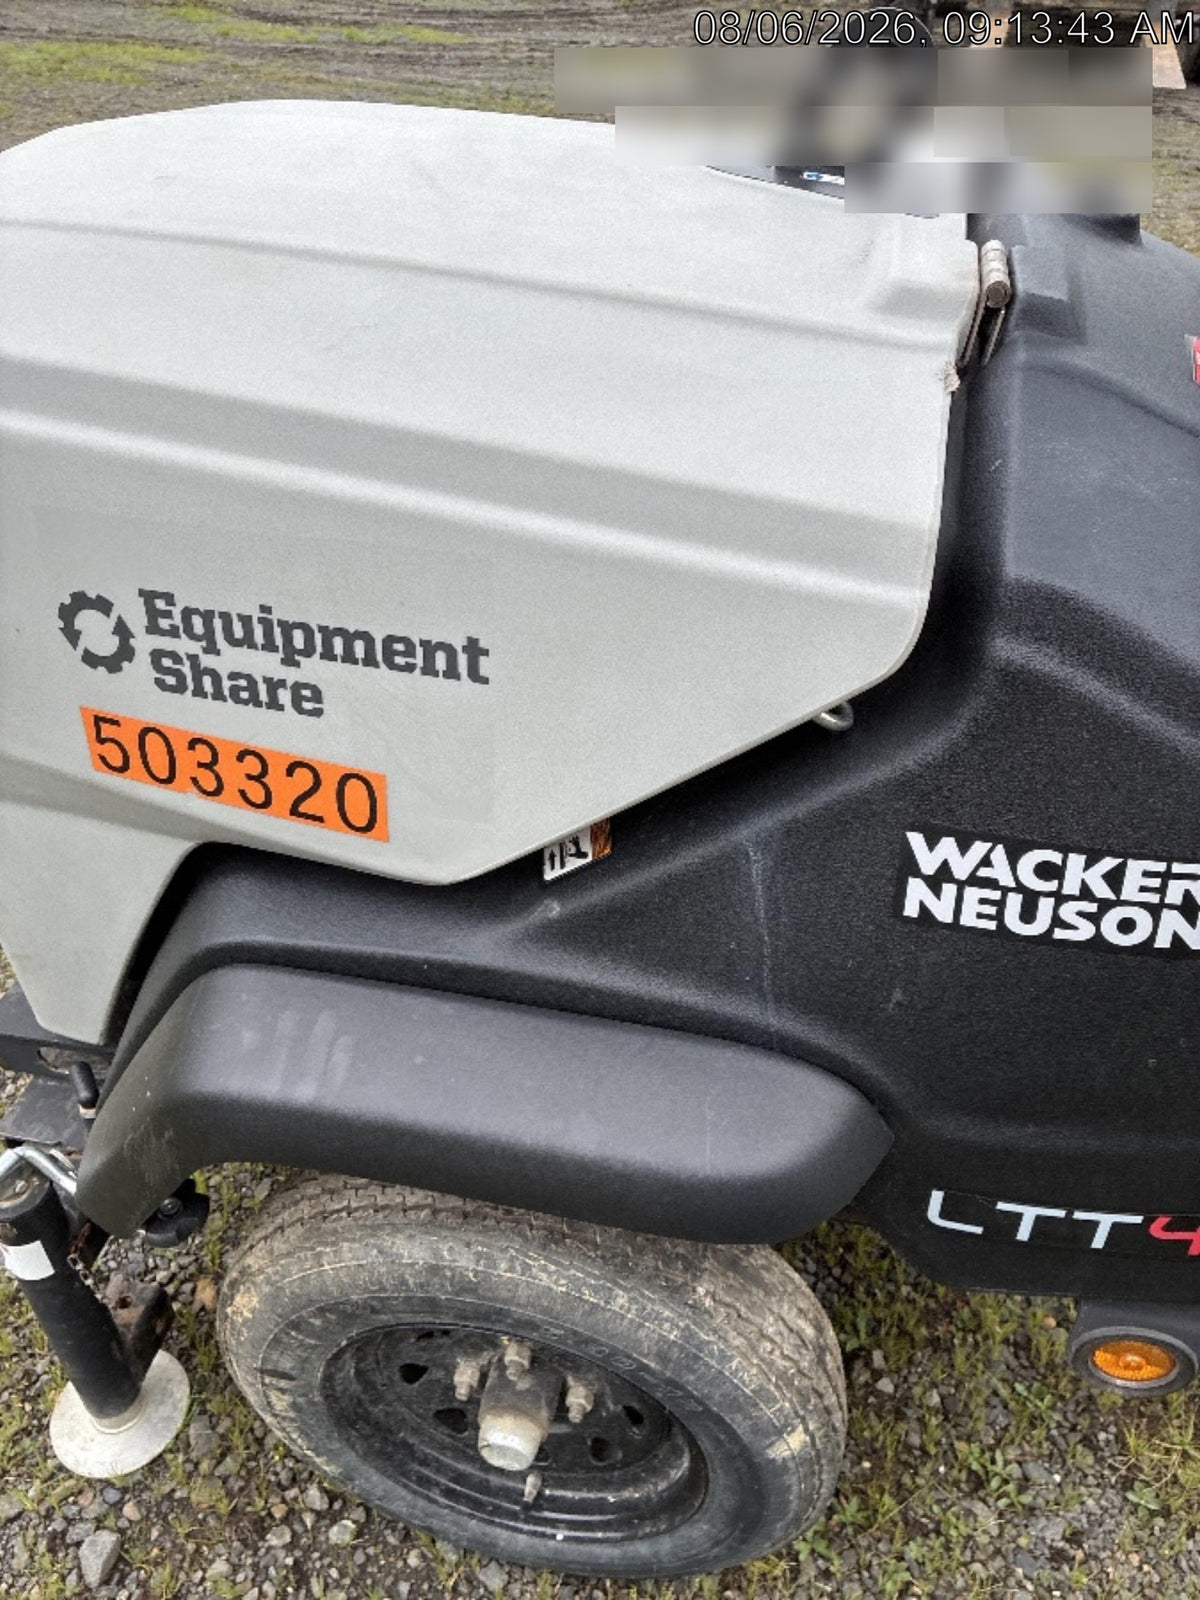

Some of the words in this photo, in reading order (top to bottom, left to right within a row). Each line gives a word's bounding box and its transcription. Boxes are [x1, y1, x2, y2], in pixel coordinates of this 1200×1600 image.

[138, 588, 490, 685] Equipment
[149, 649, 324, 717] Share
[93, 714, 378, 834] 503320
[906, 831, 1200, 906] WACKER
[902, 877, 1200, 950] NEUSON
[927, 1190, 1200, 1256] LTT4
